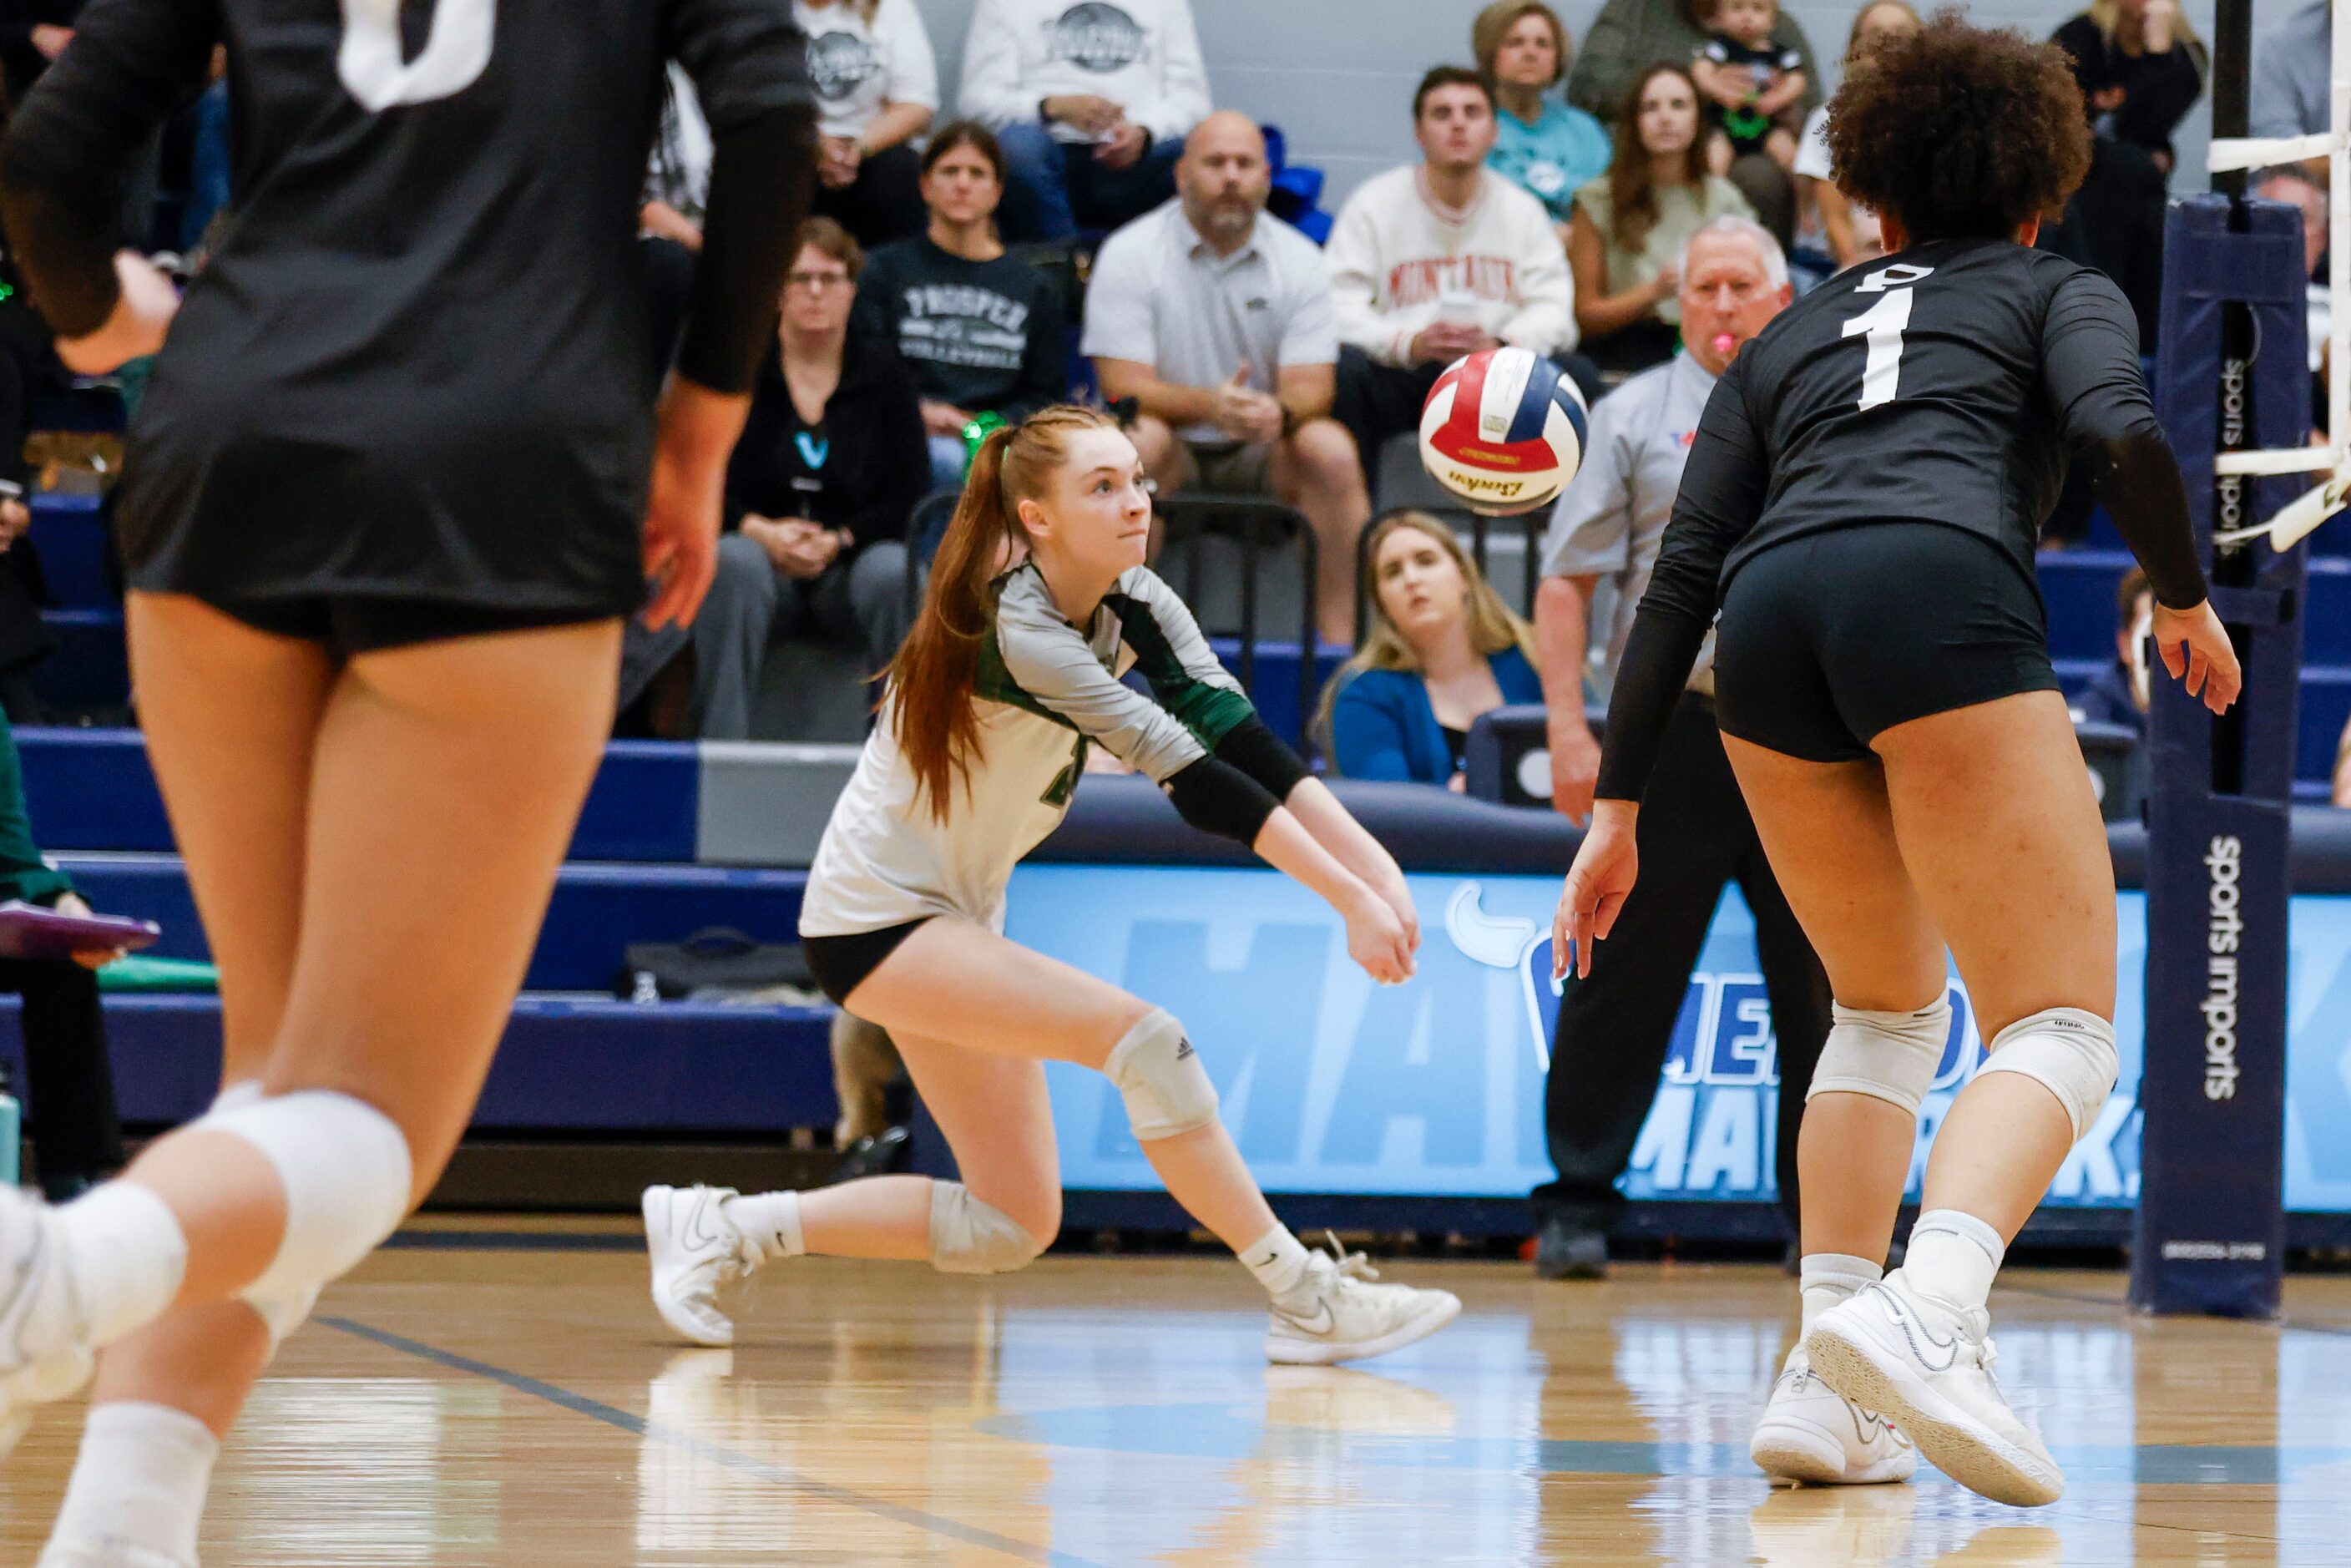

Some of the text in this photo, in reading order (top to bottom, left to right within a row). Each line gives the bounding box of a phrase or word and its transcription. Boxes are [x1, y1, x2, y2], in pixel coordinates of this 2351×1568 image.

[1853, 263, 1934, 292] P
[1841, 286, 1913, 412] 1
[2199, 835, 2245, 1100] sports imports
